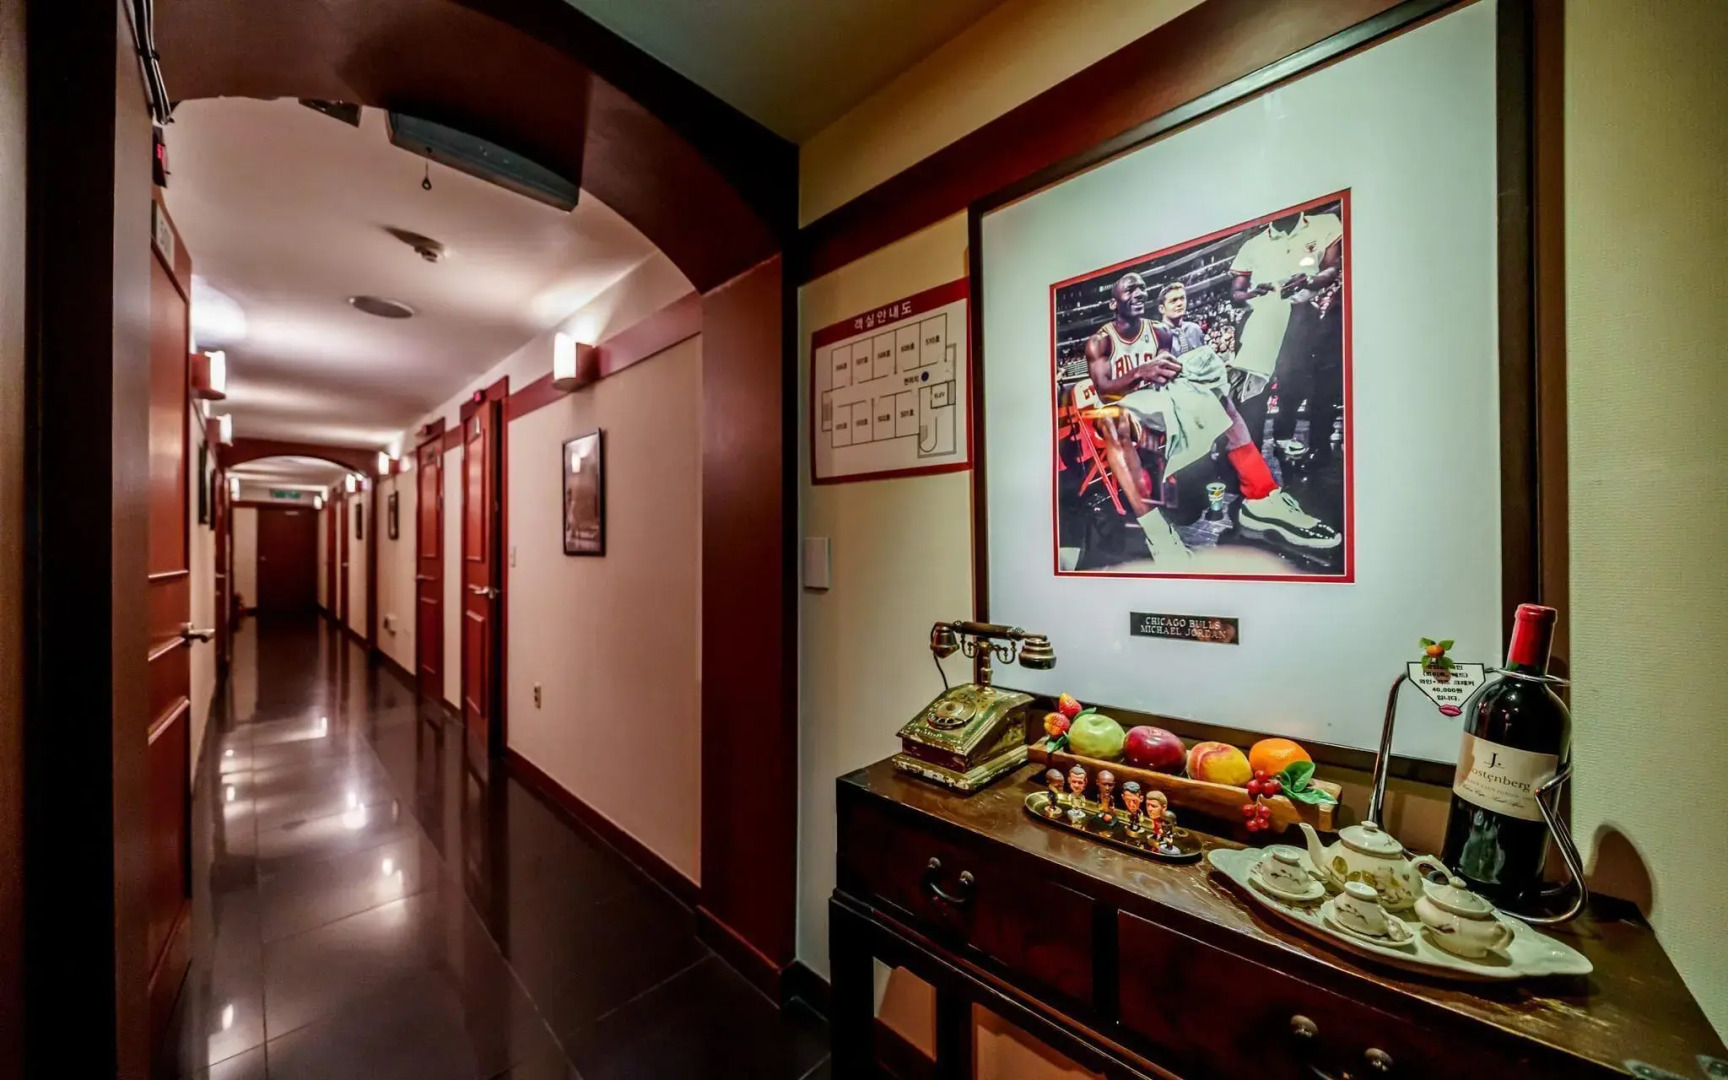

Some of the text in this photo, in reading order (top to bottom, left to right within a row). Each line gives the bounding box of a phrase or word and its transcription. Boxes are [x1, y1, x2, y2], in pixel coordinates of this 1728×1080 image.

[854, 300, 912, 330] 객실안내도
[1145, 616, 1221, 630] CHICAGO BULLS
[1140, 624, 1227, 639] MICHAEL JORDAN
